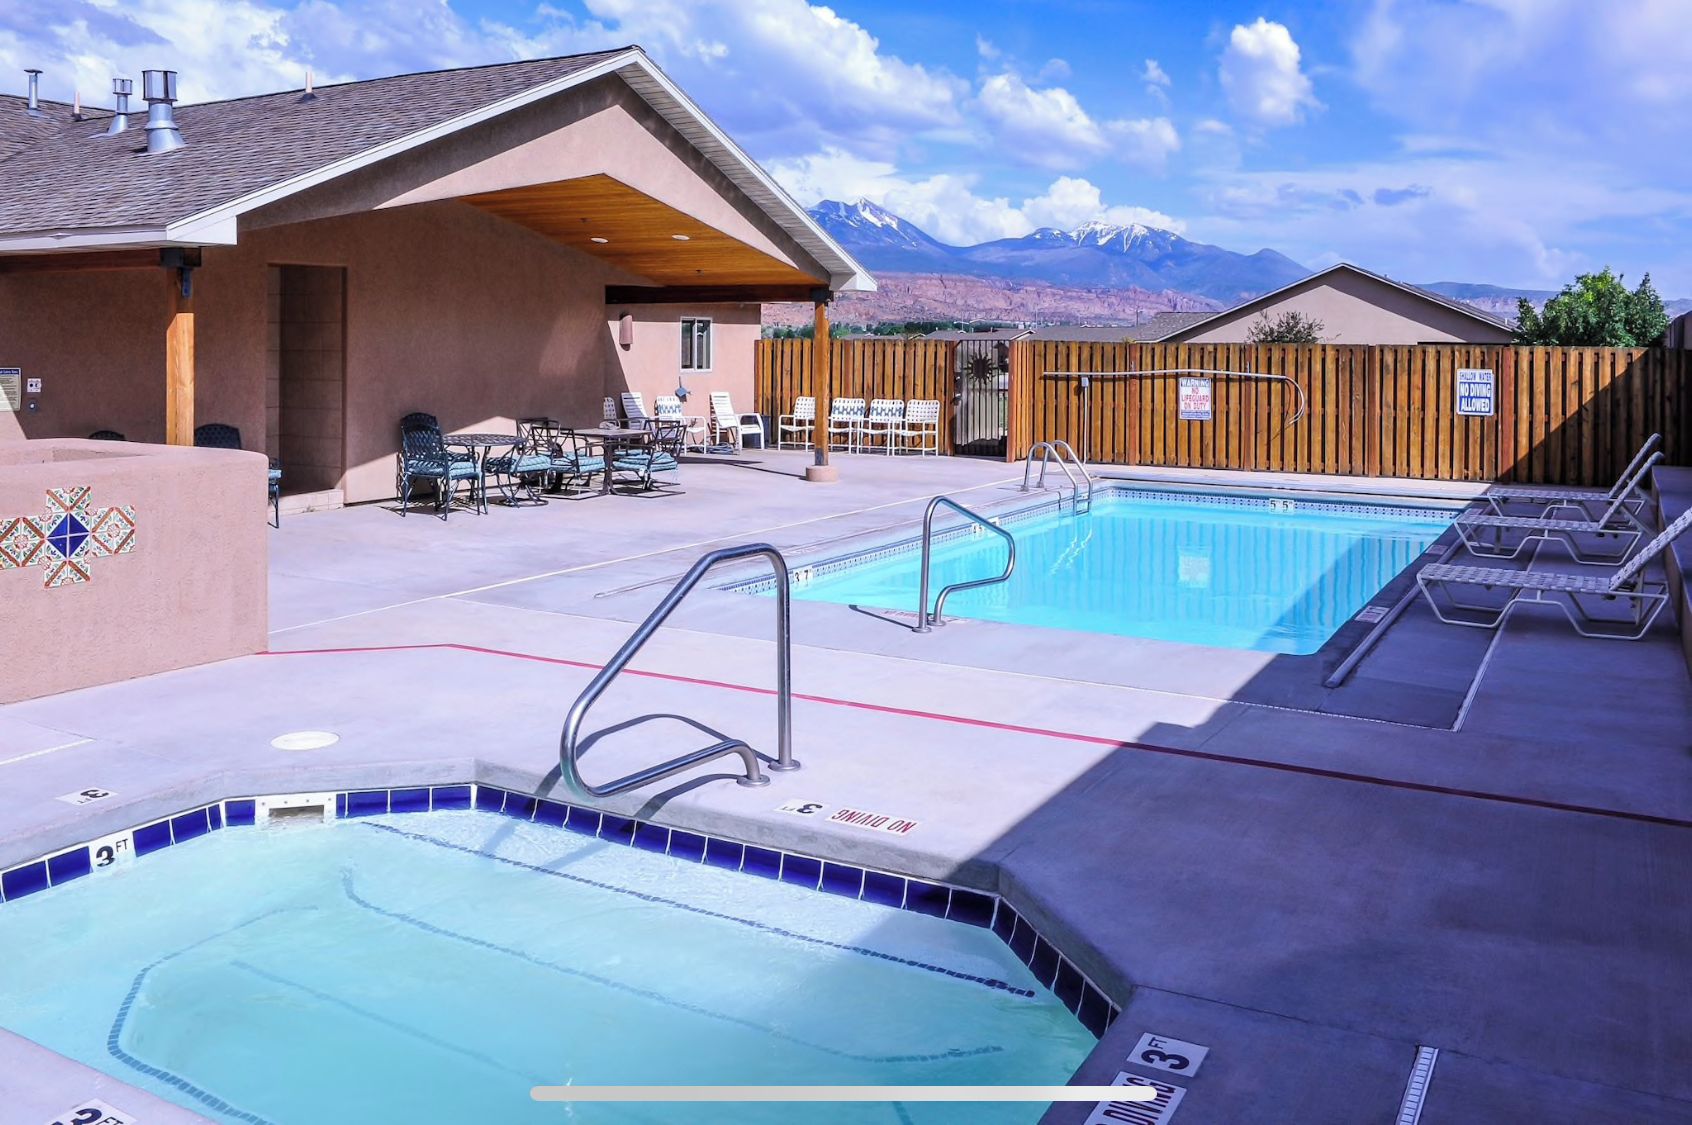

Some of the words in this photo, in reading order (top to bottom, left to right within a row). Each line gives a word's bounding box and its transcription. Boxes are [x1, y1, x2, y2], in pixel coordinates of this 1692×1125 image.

[1180, 378, 1210, 387] WARNING
[1460, 371, 1477, 381] SHALLOW
[1479, 372, 1492, 381] WATER
[1460, 383, 1469, 397] NO
[1470, 383, 1491, 397] DIVING
[1181, 394, 1210, 402] LIFEGUARD
[1460, 397, 1490, 412] ALLOWED
[1193, 402, 1207, 410] DUTY
[797, 803, 823, 814] 3
[831, 809, 890, 828] DIVING
[887, 819, 917, 834] NO
[96, 845, 116, 868] 3
[115, 838, 129, 853] FT
[1147, 1036, 1168, 1050] FT
[1141, 1049, 1190, 1070] 3
